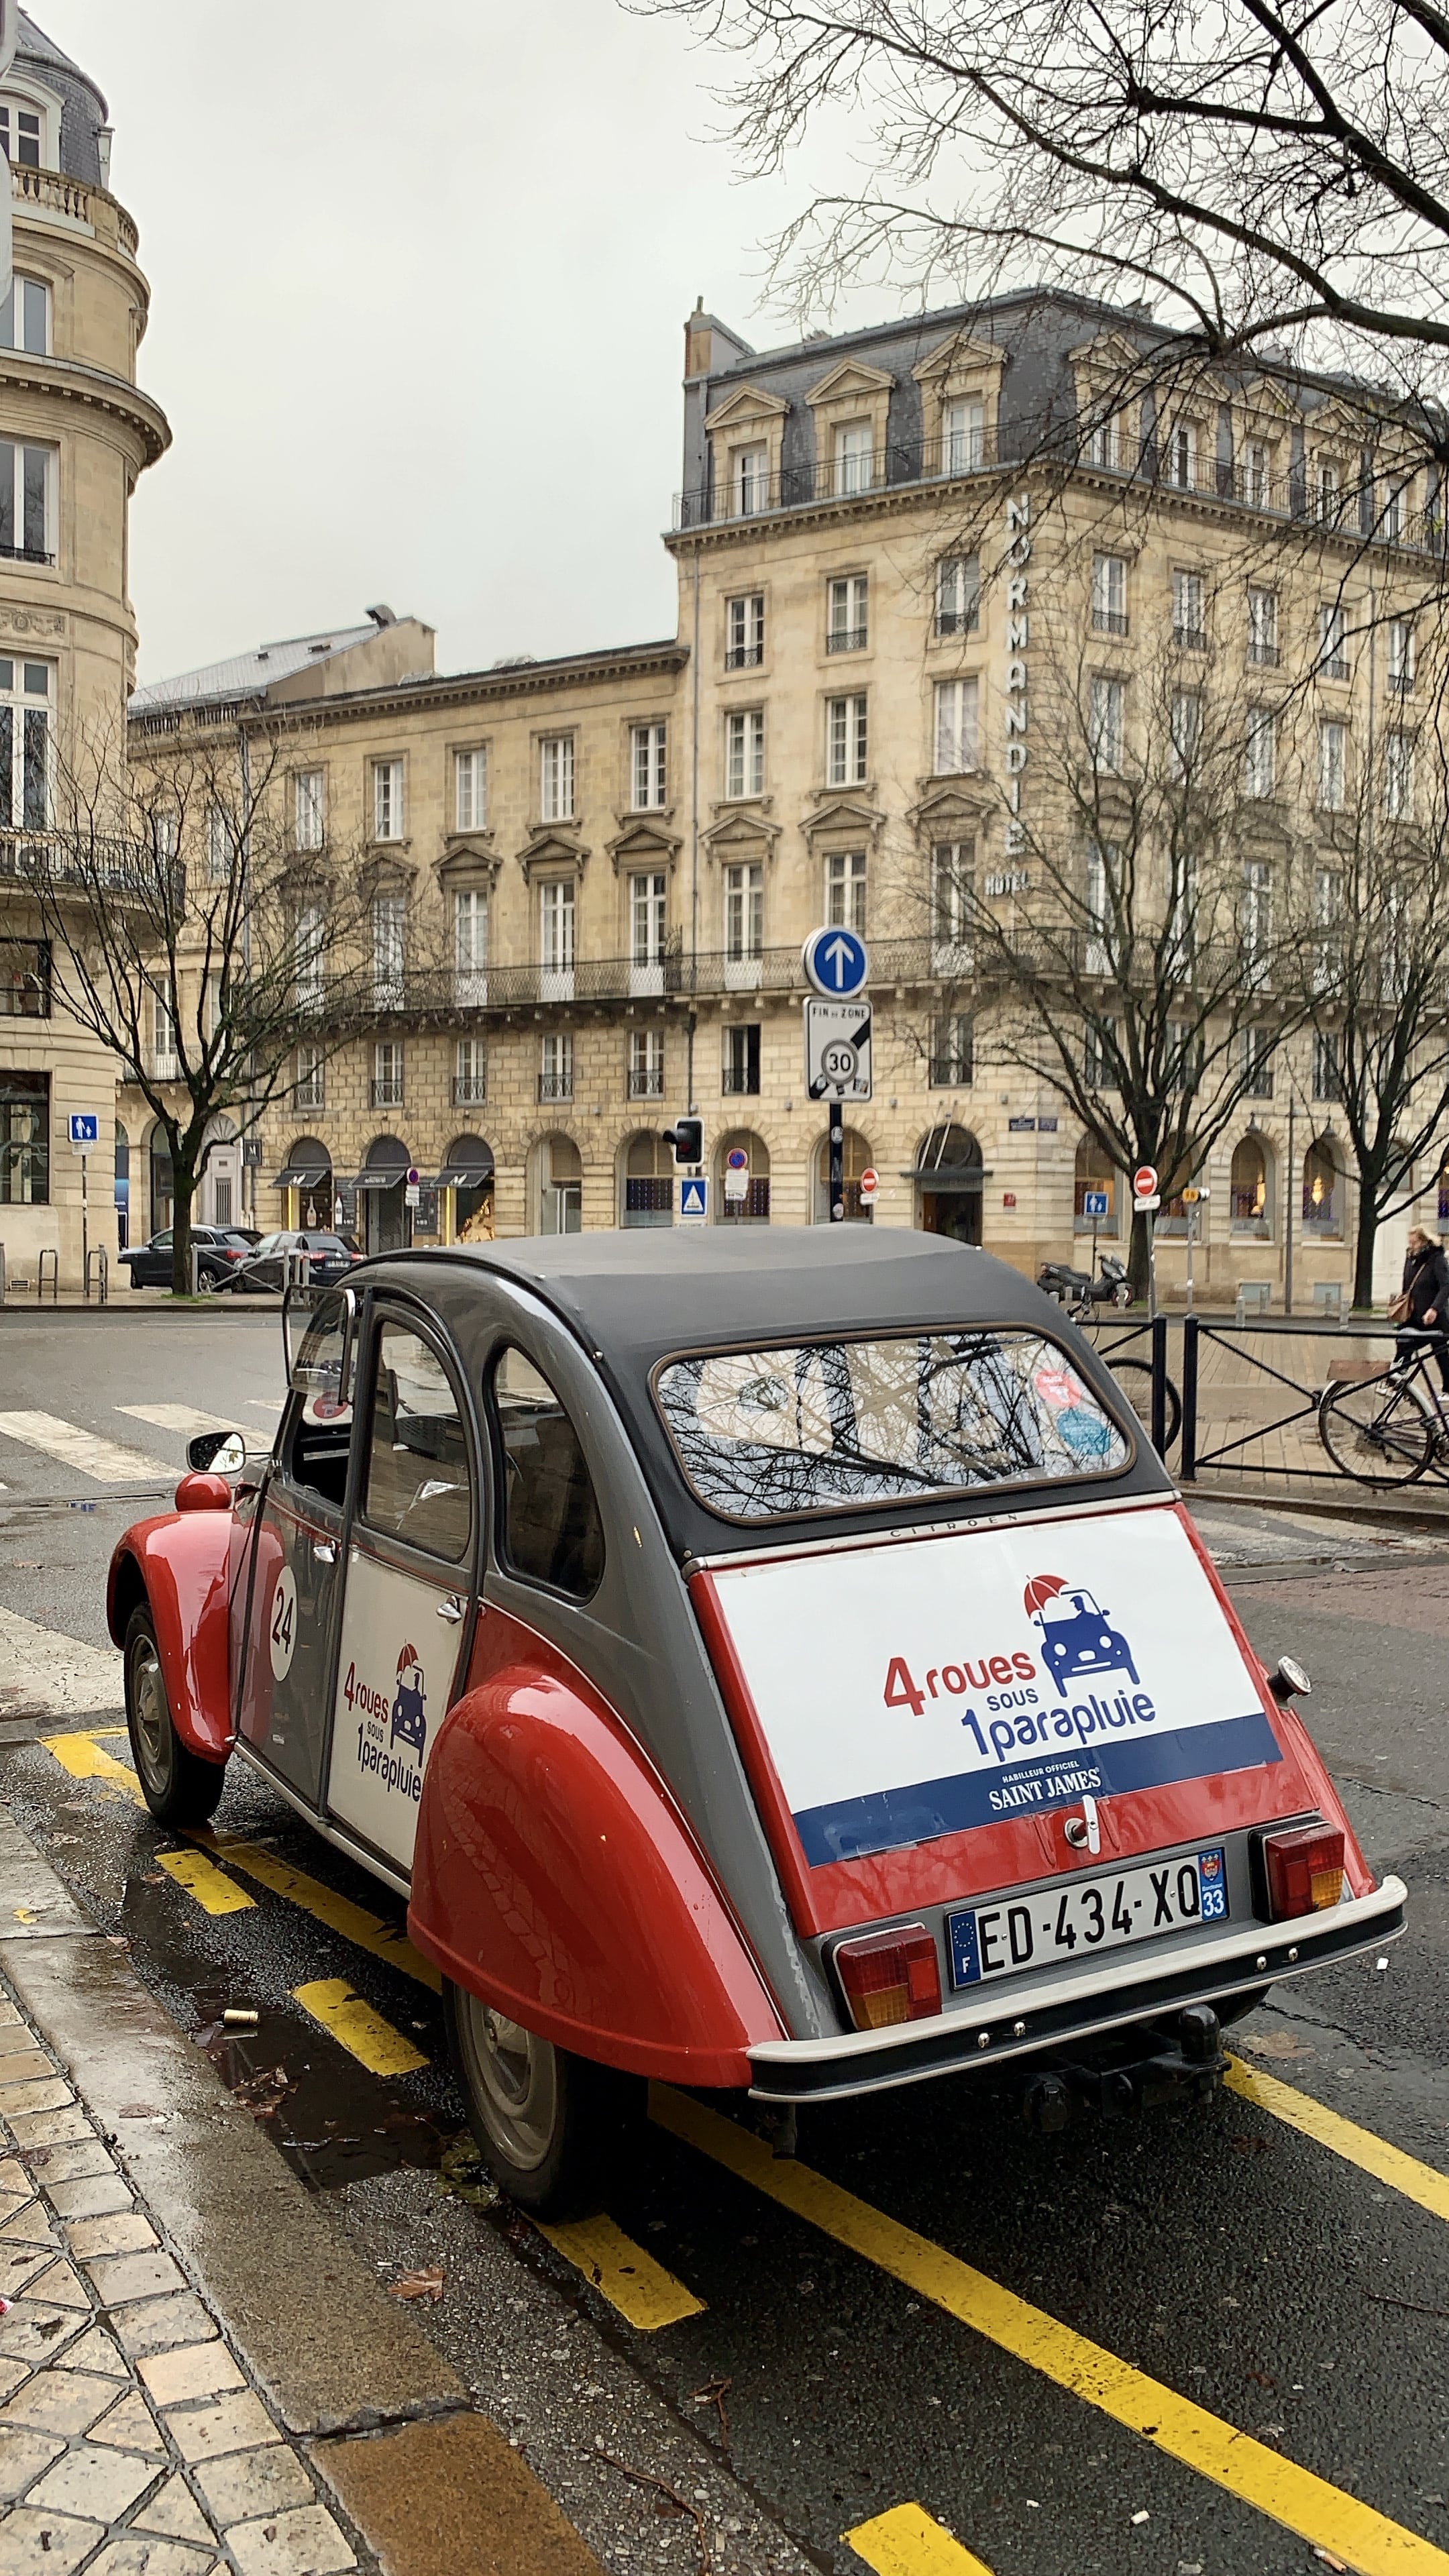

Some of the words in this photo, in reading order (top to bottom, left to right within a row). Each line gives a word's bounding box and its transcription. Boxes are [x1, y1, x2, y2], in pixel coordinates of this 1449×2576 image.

[1005, 494, 1030, 857] NORMANDIE
[812, 1007, 829, 1018] FIN
[841, 1008, 866, 1019] ZONE
[829, 1053, 851, 1071] 30
[890, 1513, 1018, 1538] CITROEN
[271, 1585, 294, 1655] 24
[986, 1688, 1039, 1711] sous
[367, 1721, 384, 1743] sous
[1002, 1767, 1044, 1784] HABILLEUR
[1044, 1760, 1080, 1774] OFFICIEL
[989, 1780, 1044, 1811] SAINT
[1203, 1889, 1225, 1917] 33
[977, 1864, 1201, 1974] ED-434-XQ
[962, 1956, 971, 1974] F
